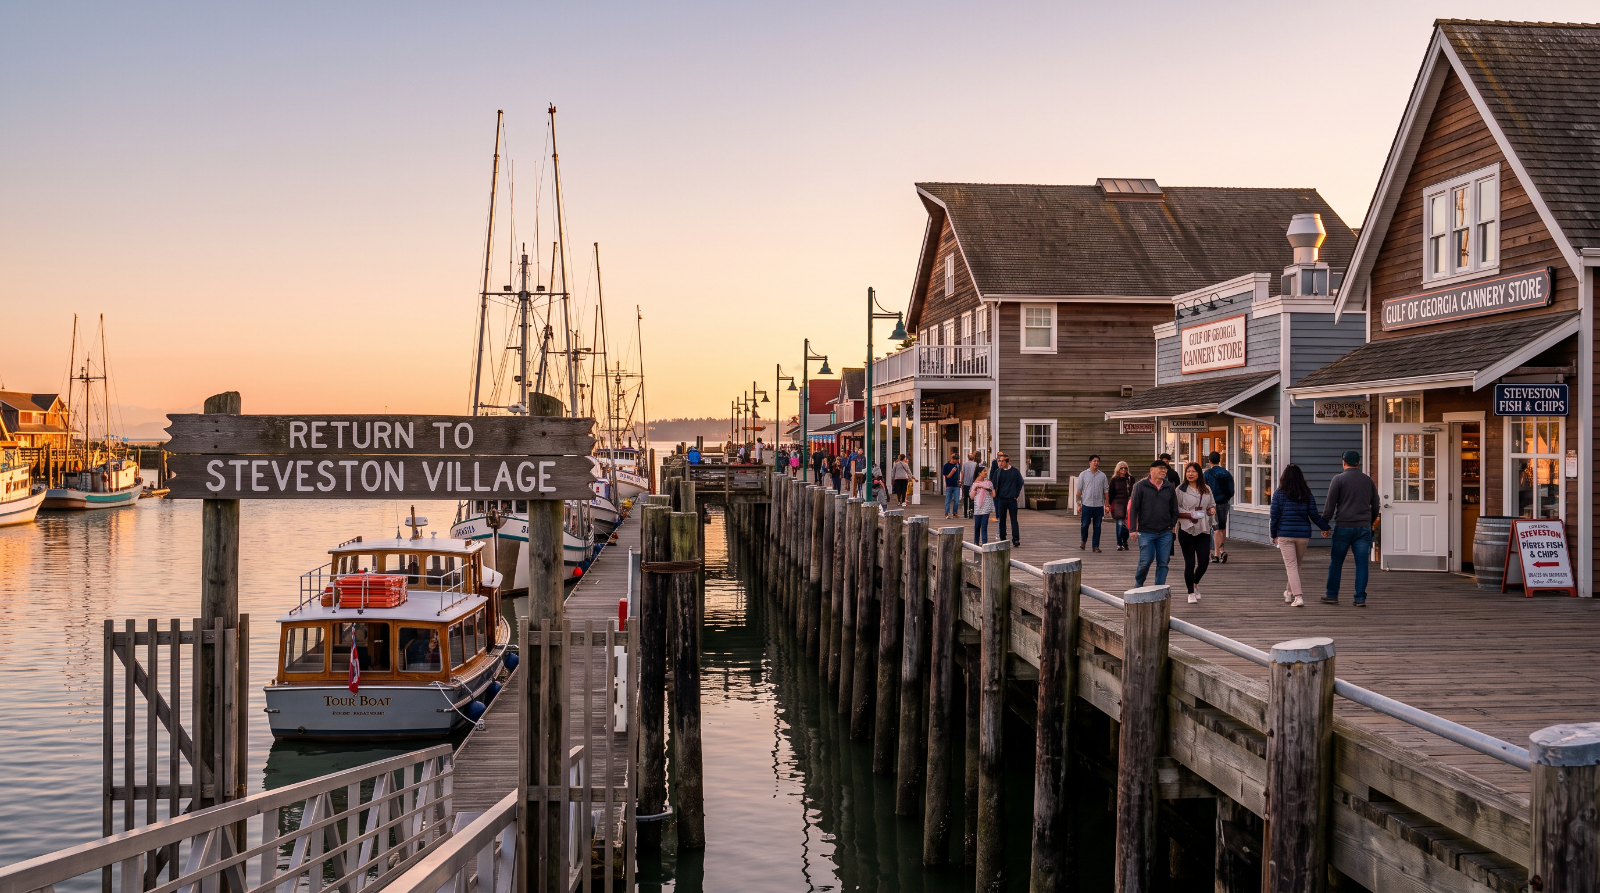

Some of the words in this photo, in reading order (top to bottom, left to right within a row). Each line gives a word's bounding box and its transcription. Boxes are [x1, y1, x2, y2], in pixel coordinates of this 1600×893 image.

[1386, 303, 1406, 324] GULF
[1407, 301, 1419, 321] OF
[1420, 294, 1459, 318] GEORGIA
[1460, 284, 1506, 311] CANNERY
[1508, 276, 1543, 303] STORE
[1189, 331, 1203, 346] GULF
[1203, 329, 1212, 343] OF
[1183, 345, 1216, 367] CANNERY
[1217, 340, 1243, 361] STORE
[1503, 387, 1560, 399] STEVESTON
[1499, 400, 1523, 412] FISH
[1525, 401, 1533, 411] &
[1534, 400, 1565, 412] CHIPS
[289, 421, 414, 449] RETURN
[432, 422, 474, 449] TO
[205, 459, 404, 492] STEVESTON
[421, 460, 557, 492] VILLAGE
[1520, 530, 1561, 539] STEVESTON
[1546, 541, 1564, 549] FISH
